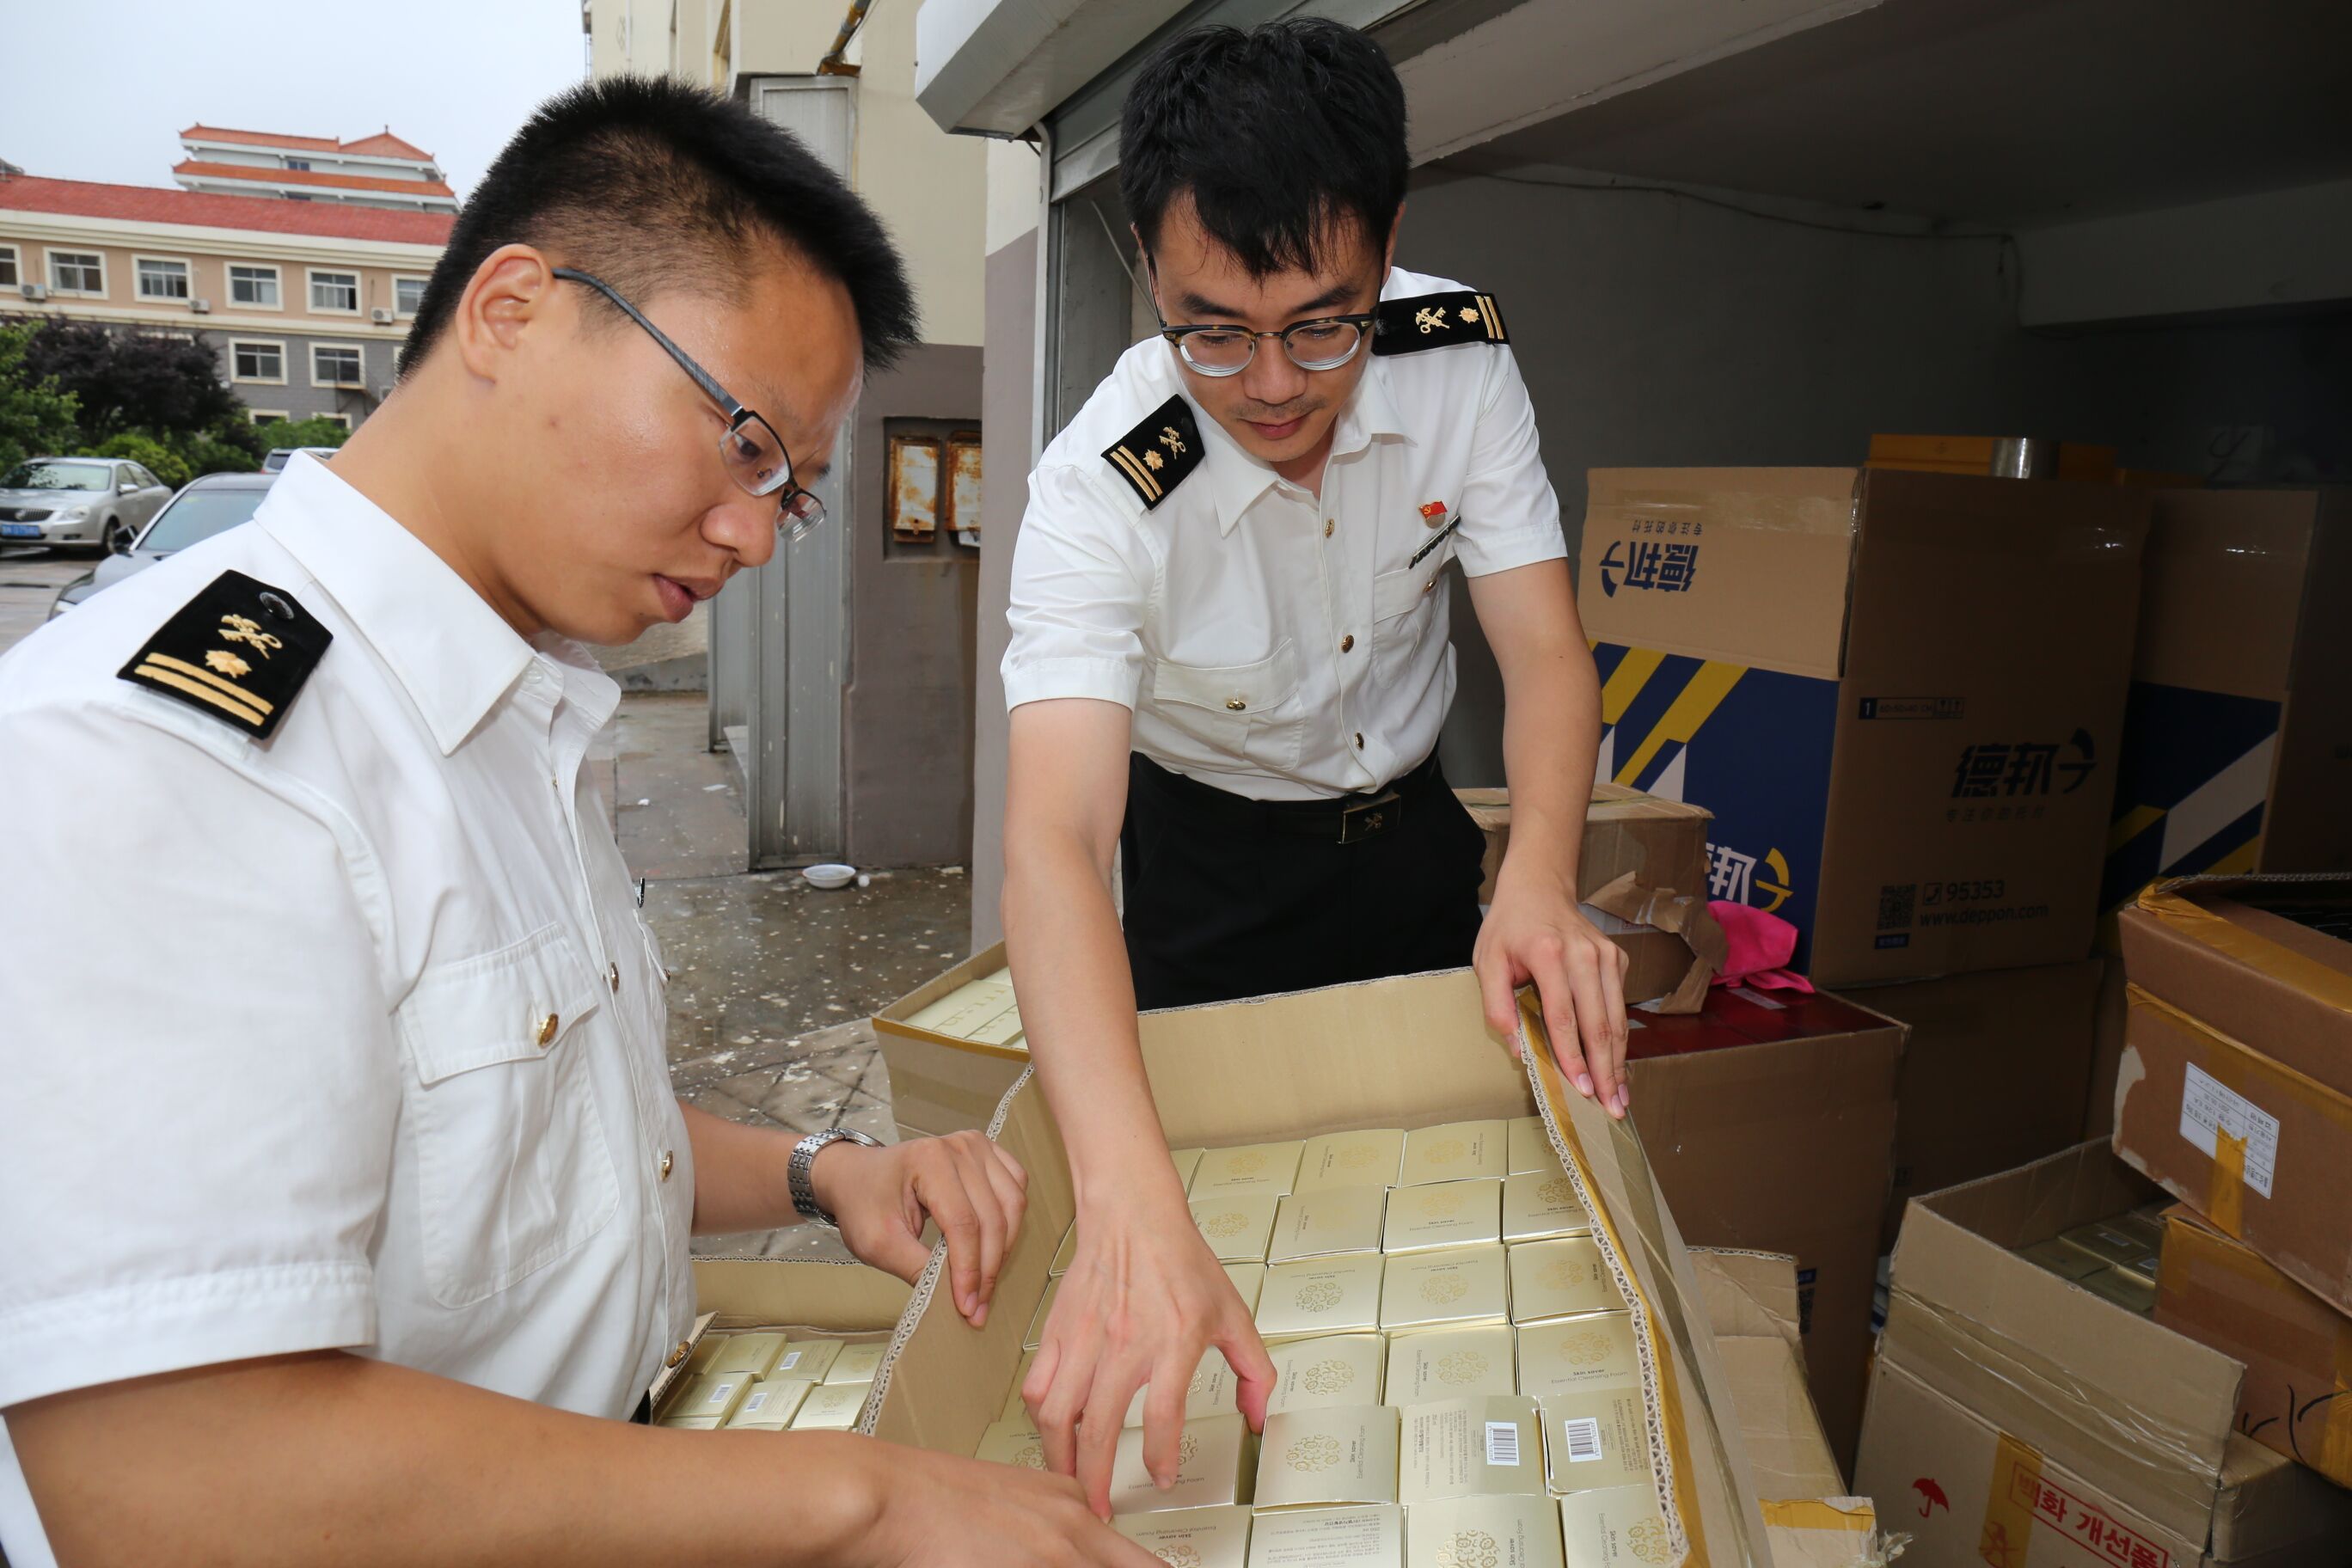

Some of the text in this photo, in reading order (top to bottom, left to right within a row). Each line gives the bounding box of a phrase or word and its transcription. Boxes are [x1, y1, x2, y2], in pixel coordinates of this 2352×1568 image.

[1632, 520, 1703, 536] 专注你的托付
[1623, 542, 1699, 592] 德邦
[1951, 742, 2060, 798] 德邦
[1946, 880, 2005, 901] 95353
[1920, 903, 2049, 927] www.deppon.com
